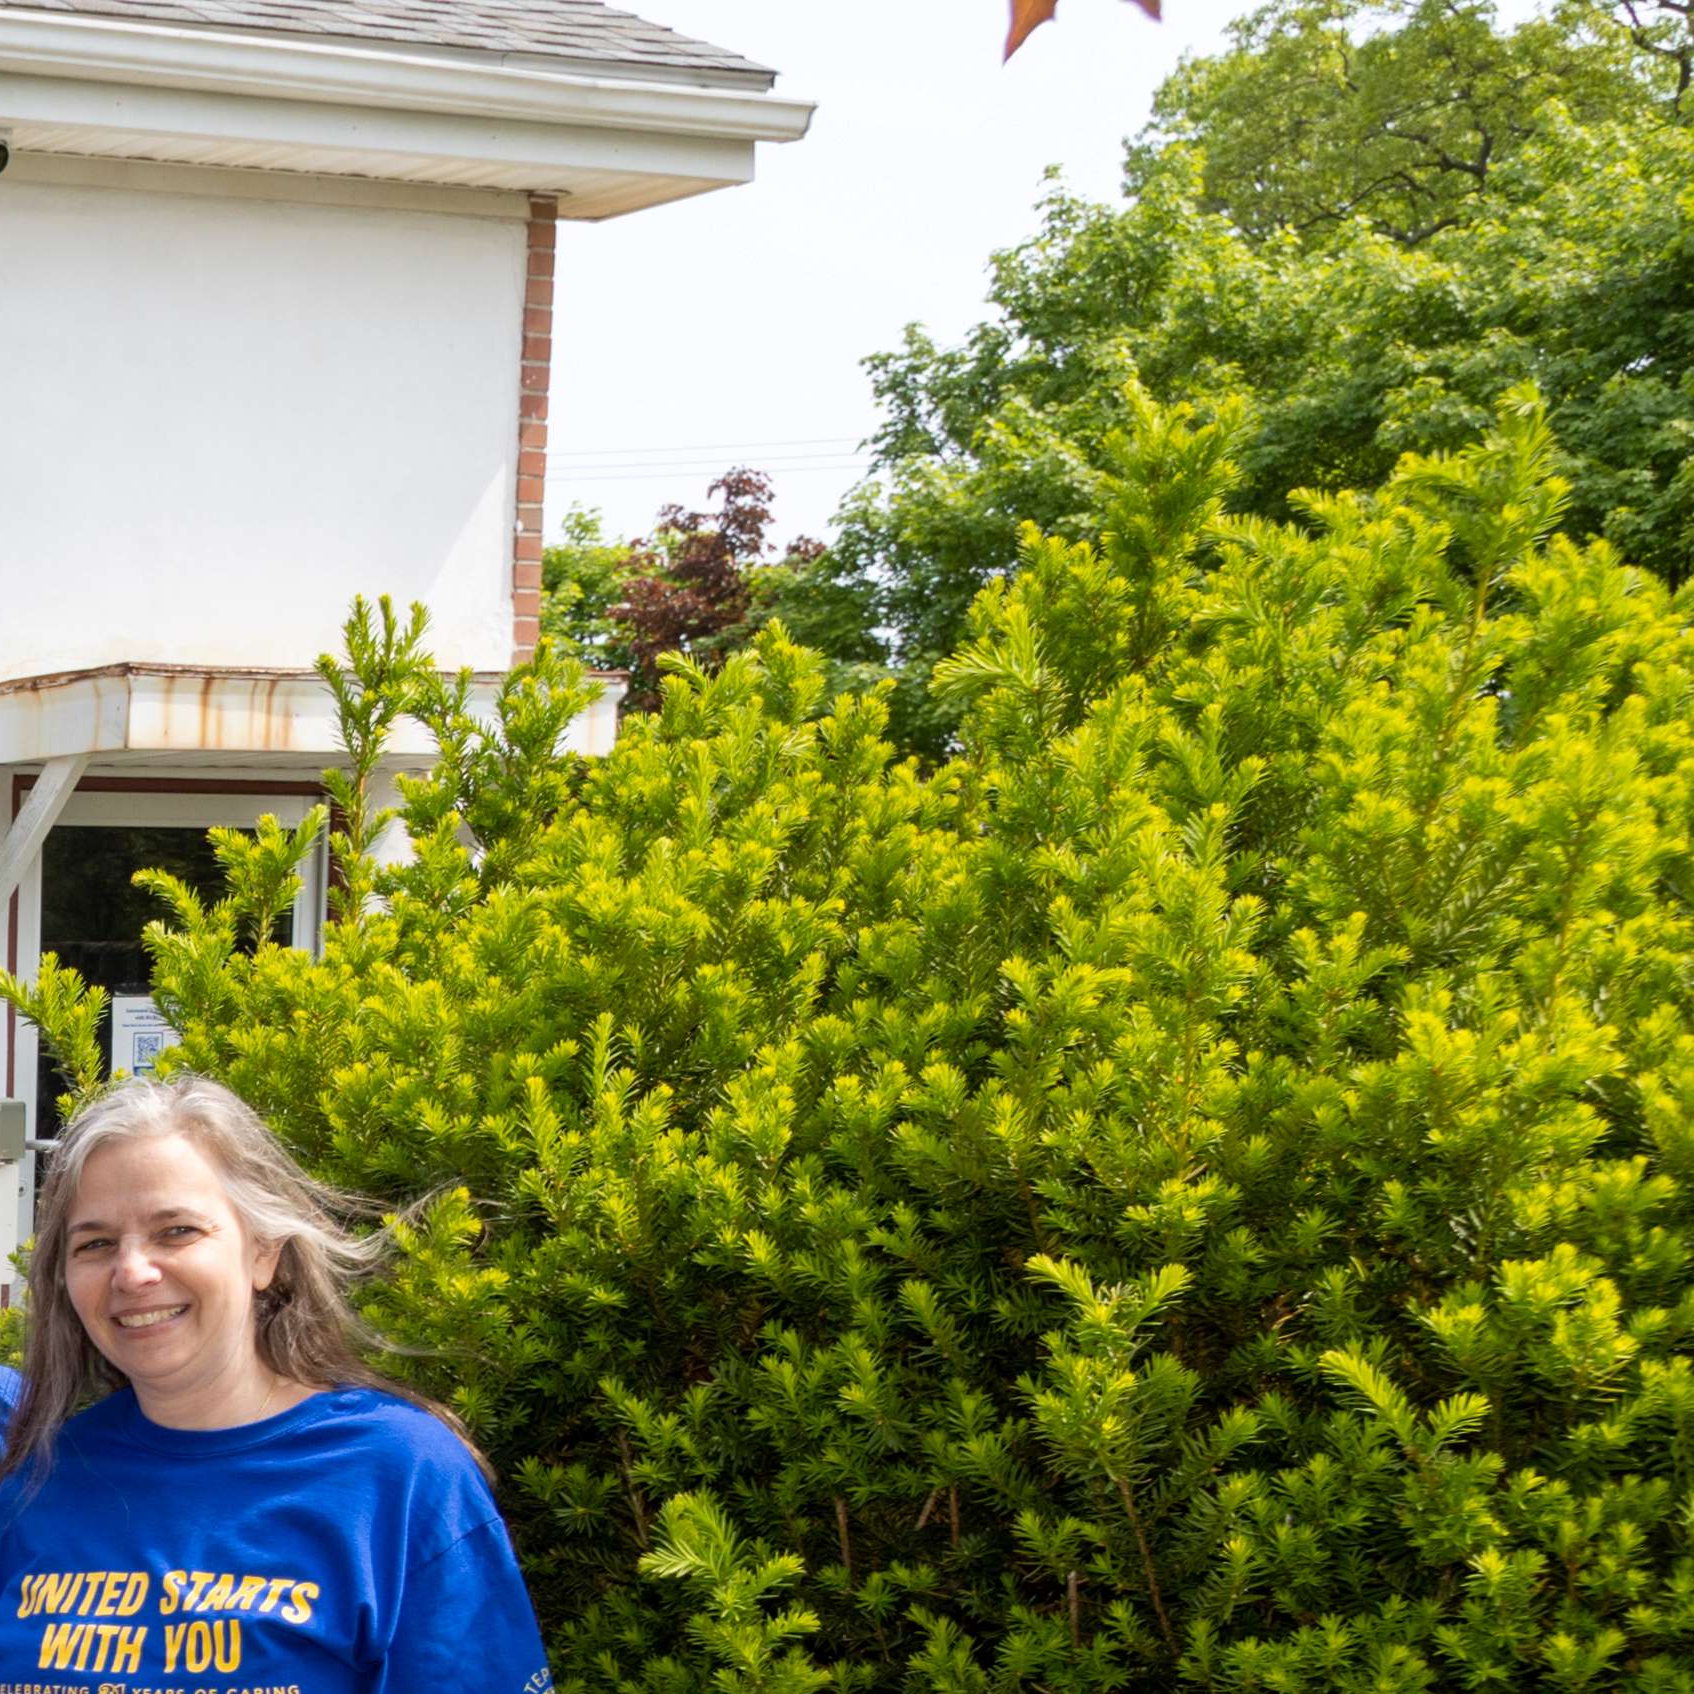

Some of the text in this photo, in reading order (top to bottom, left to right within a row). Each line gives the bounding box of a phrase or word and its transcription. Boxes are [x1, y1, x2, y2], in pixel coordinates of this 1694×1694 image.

[16, 1569, 320, 1624] UNITED STARTS
[37, 1619, 242, 1674] WITH YOU
